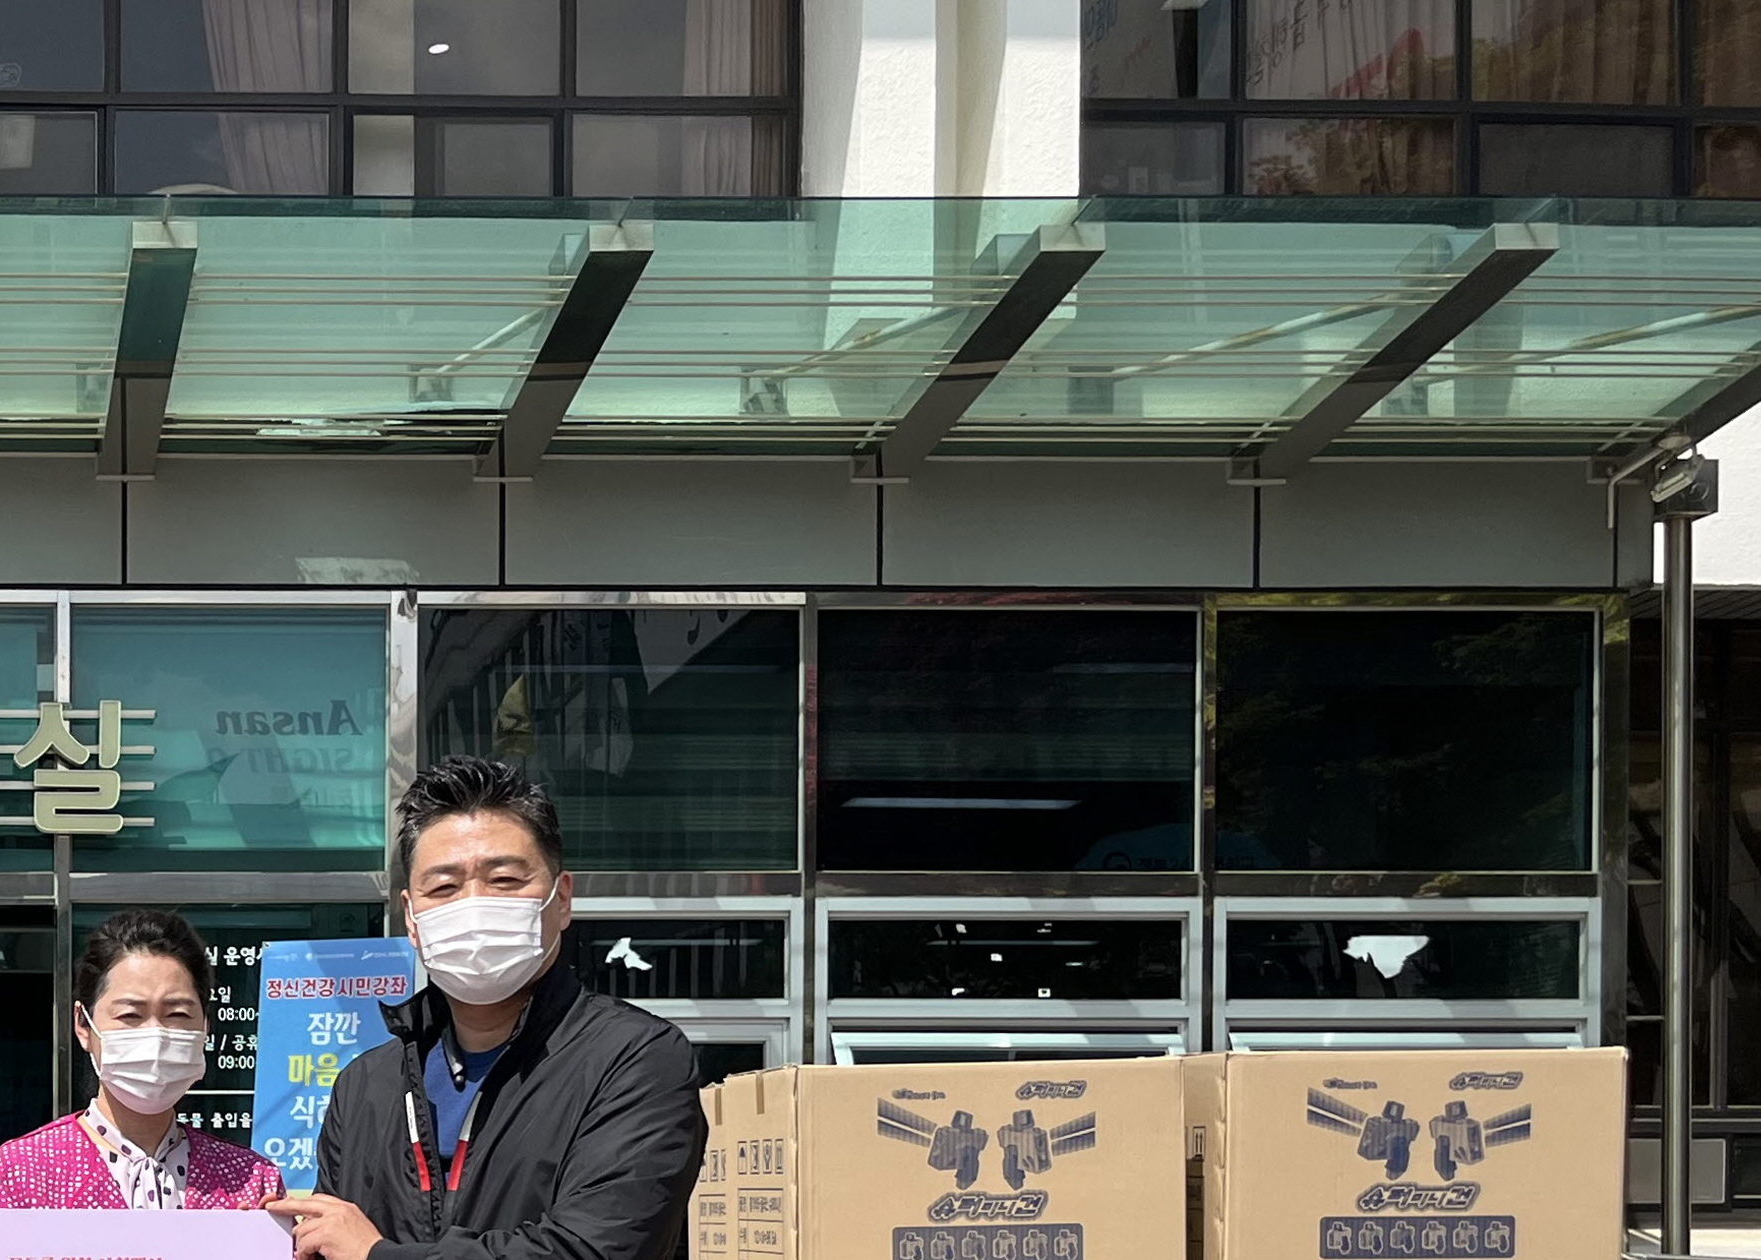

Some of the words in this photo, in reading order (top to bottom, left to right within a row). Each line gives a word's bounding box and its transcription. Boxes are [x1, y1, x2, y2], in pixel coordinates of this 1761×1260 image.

[307, 1012, 361, 1045] 잠깐
[218, 1056, 254, 1069] 09:00
[289, 1053, 340, 1086] 마음
[211, 1112, 253, 1128] 출입을
[264, 1138, 317, 1170] 오겠
[930, 1195, 1046, 1219] 슈퍼미니건
[1360, 1185, 1477, 1210] 슈퍼미니건
